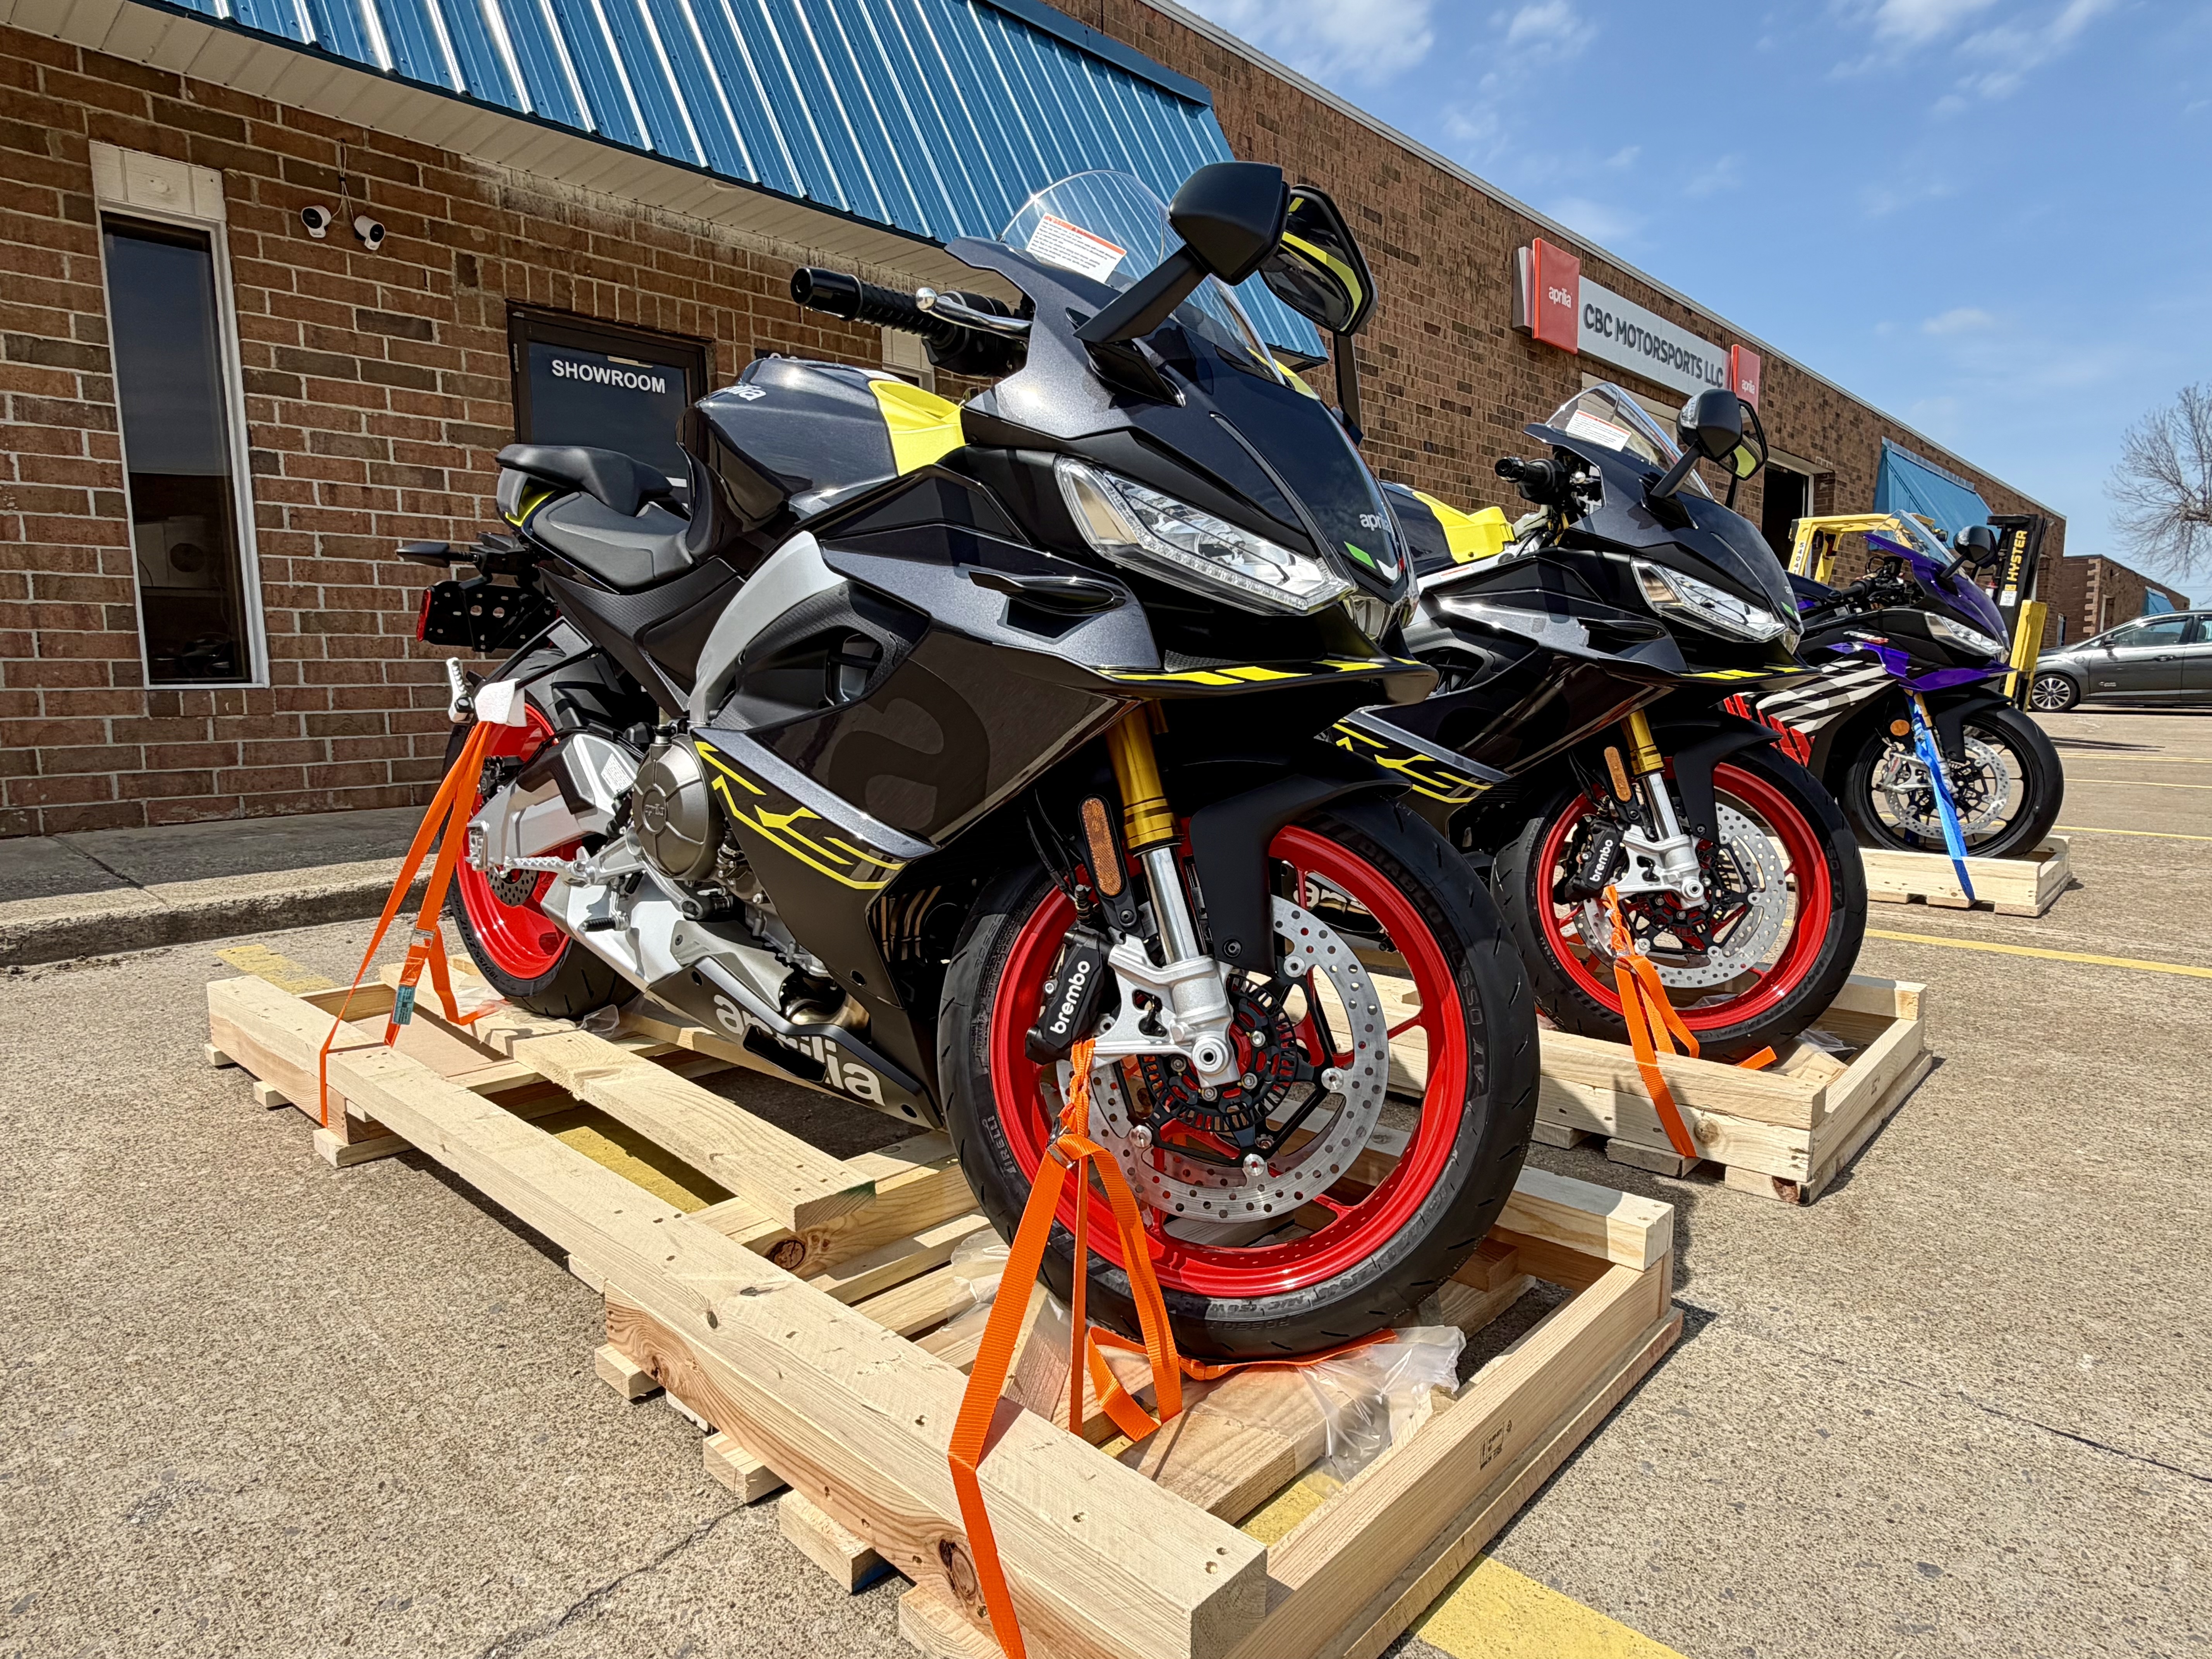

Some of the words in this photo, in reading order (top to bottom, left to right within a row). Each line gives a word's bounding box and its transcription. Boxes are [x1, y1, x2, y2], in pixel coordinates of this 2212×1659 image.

[1548, 286, 1572, 309] aprilia
[1583, 303, 1613, 338] CBC
[1614, 317, 1703, 380] MOTORSPORTS
[1704, 358, 1724, 388] LLC
[552, 359, 666, 394] SHOWROOM
[2007, 530, 2028, 582] HYSTER
[1589, 839, 1613, 882] brembo
[1050, 960, 1091, 1034] brembo
